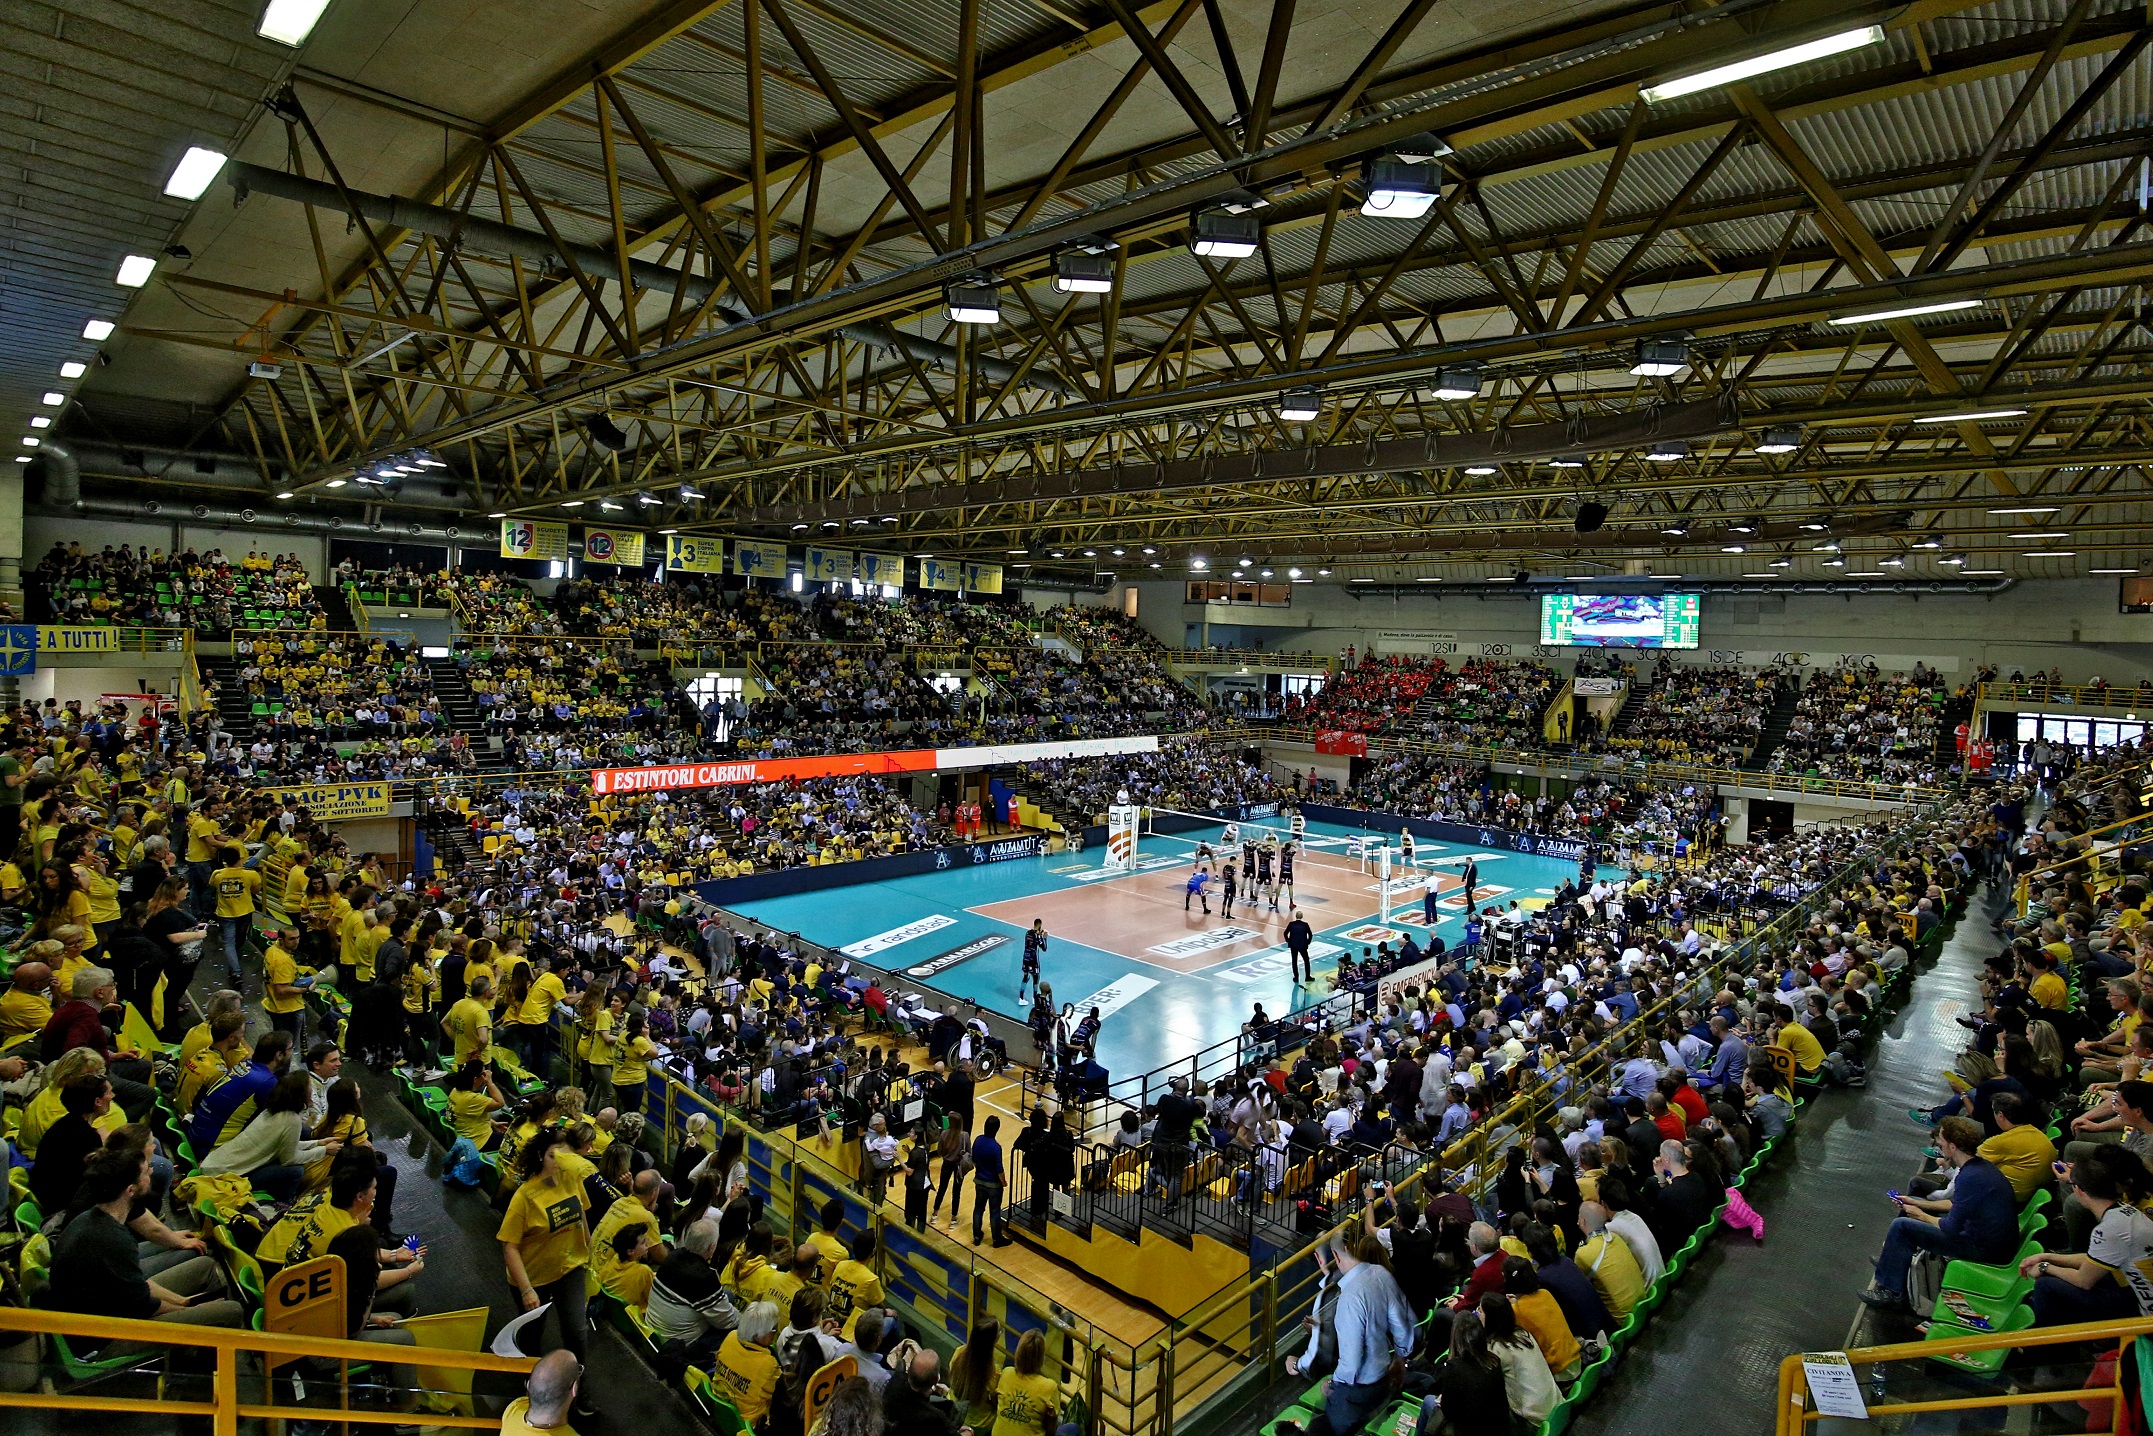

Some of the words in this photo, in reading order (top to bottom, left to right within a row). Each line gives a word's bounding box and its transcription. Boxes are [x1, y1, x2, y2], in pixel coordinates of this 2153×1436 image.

[506, 529, 531, 547] 12
[589, 537, 611, 554] 12
[683, 544, 697, 562] 3
[751, 552, 763, 568] 4
[825, 558, 836, 573] 3
[936, 568, 946, 582] 4
[47, 631, 57, 648] A
[62, 631, 107, 649] TUTTI
[613, 768, 695, 789] ESTINTORI
[698, 764, 757, 784] CABRINI
[302, 800, 367, 811] SSOCIAZIONE
[331, 805, 386, 816] SOTTORETE
[880, 917, 950, 944] randstad
[1151, 926, 1250, 955] UnipolSai
[1393, 965, 1438, 993] EMERGENCY
[279, 1268, 332, 1307] CE
[768, 1287, 791, 1306] TRAINER
[1806, 1368, 1852, 1377] CIVITANOVA
